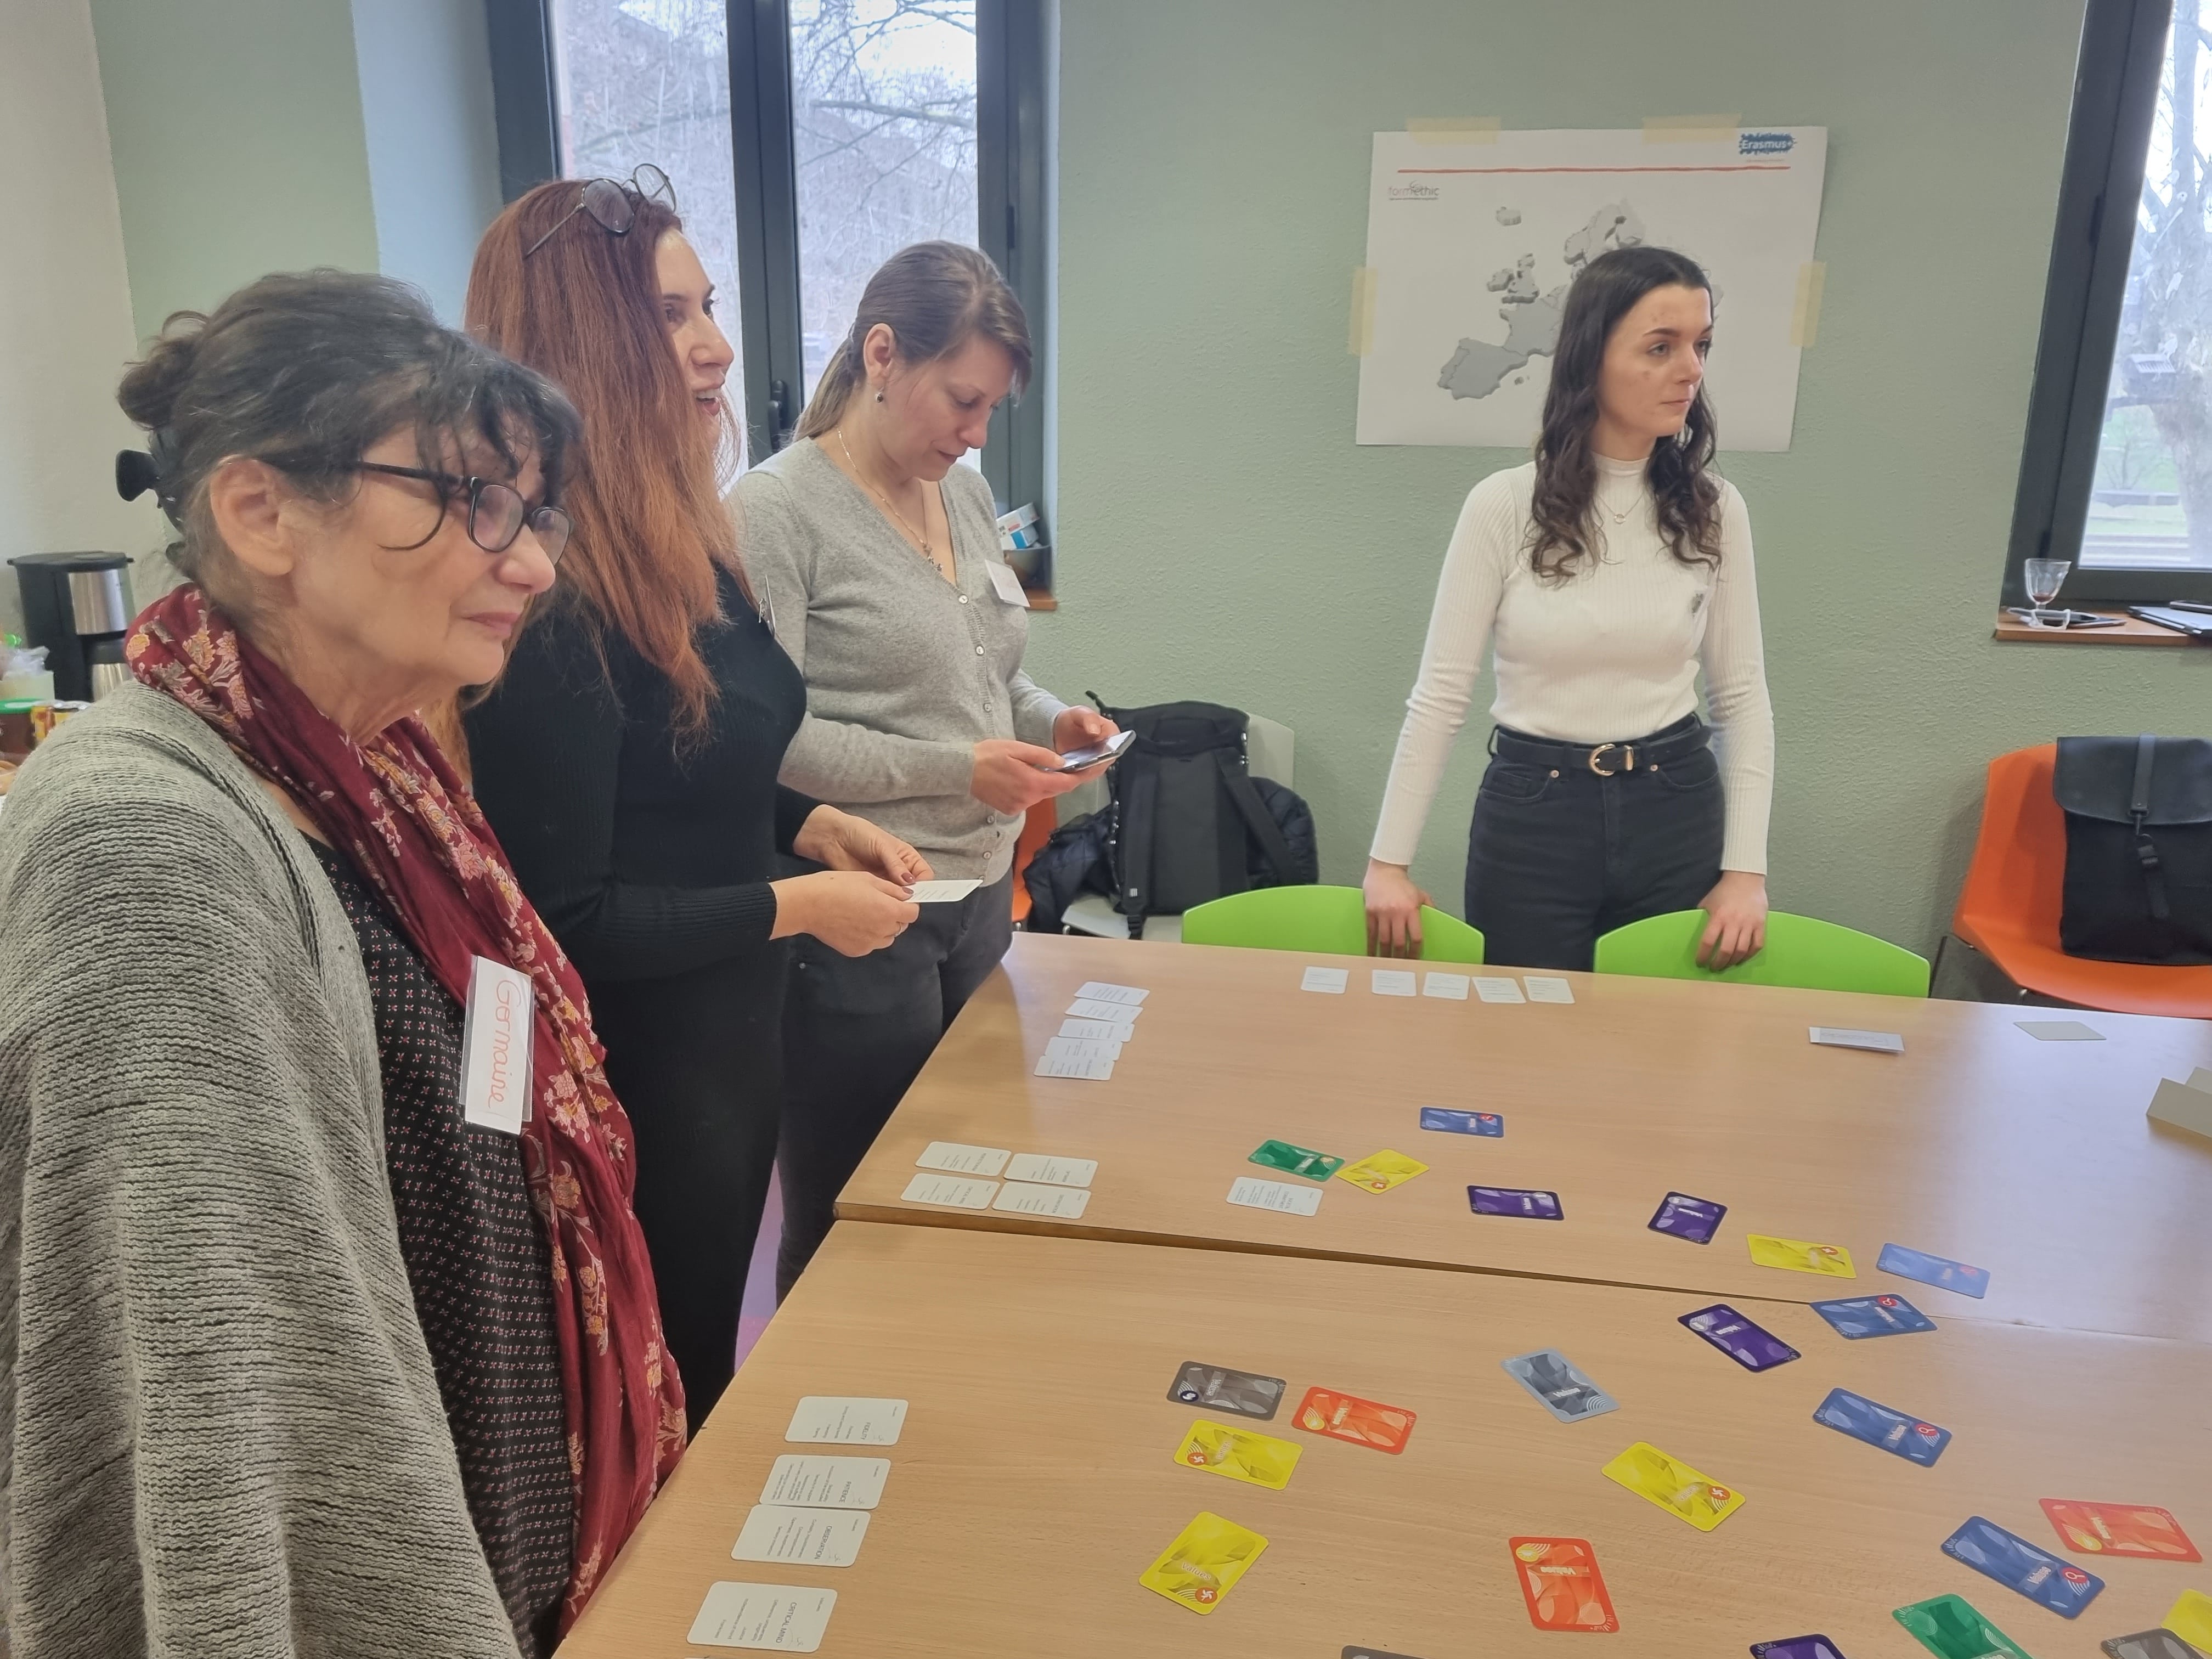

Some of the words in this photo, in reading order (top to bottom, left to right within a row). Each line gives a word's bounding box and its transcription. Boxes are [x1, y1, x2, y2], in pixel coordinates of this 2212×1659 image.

[1741, 139, 1792, 149] Erasmus+
[860, 1422, 871, 1440] FIDELITY
[839, 1481, 851, 1503] PATIENCE
[814, 1526, 832, 1559] OBSERVATION
[1181, 1562, 1212, 1581] Values
[782, 1602, 797, 1627] CRITICAL
[776, 1628, 787, 1643] MIND
